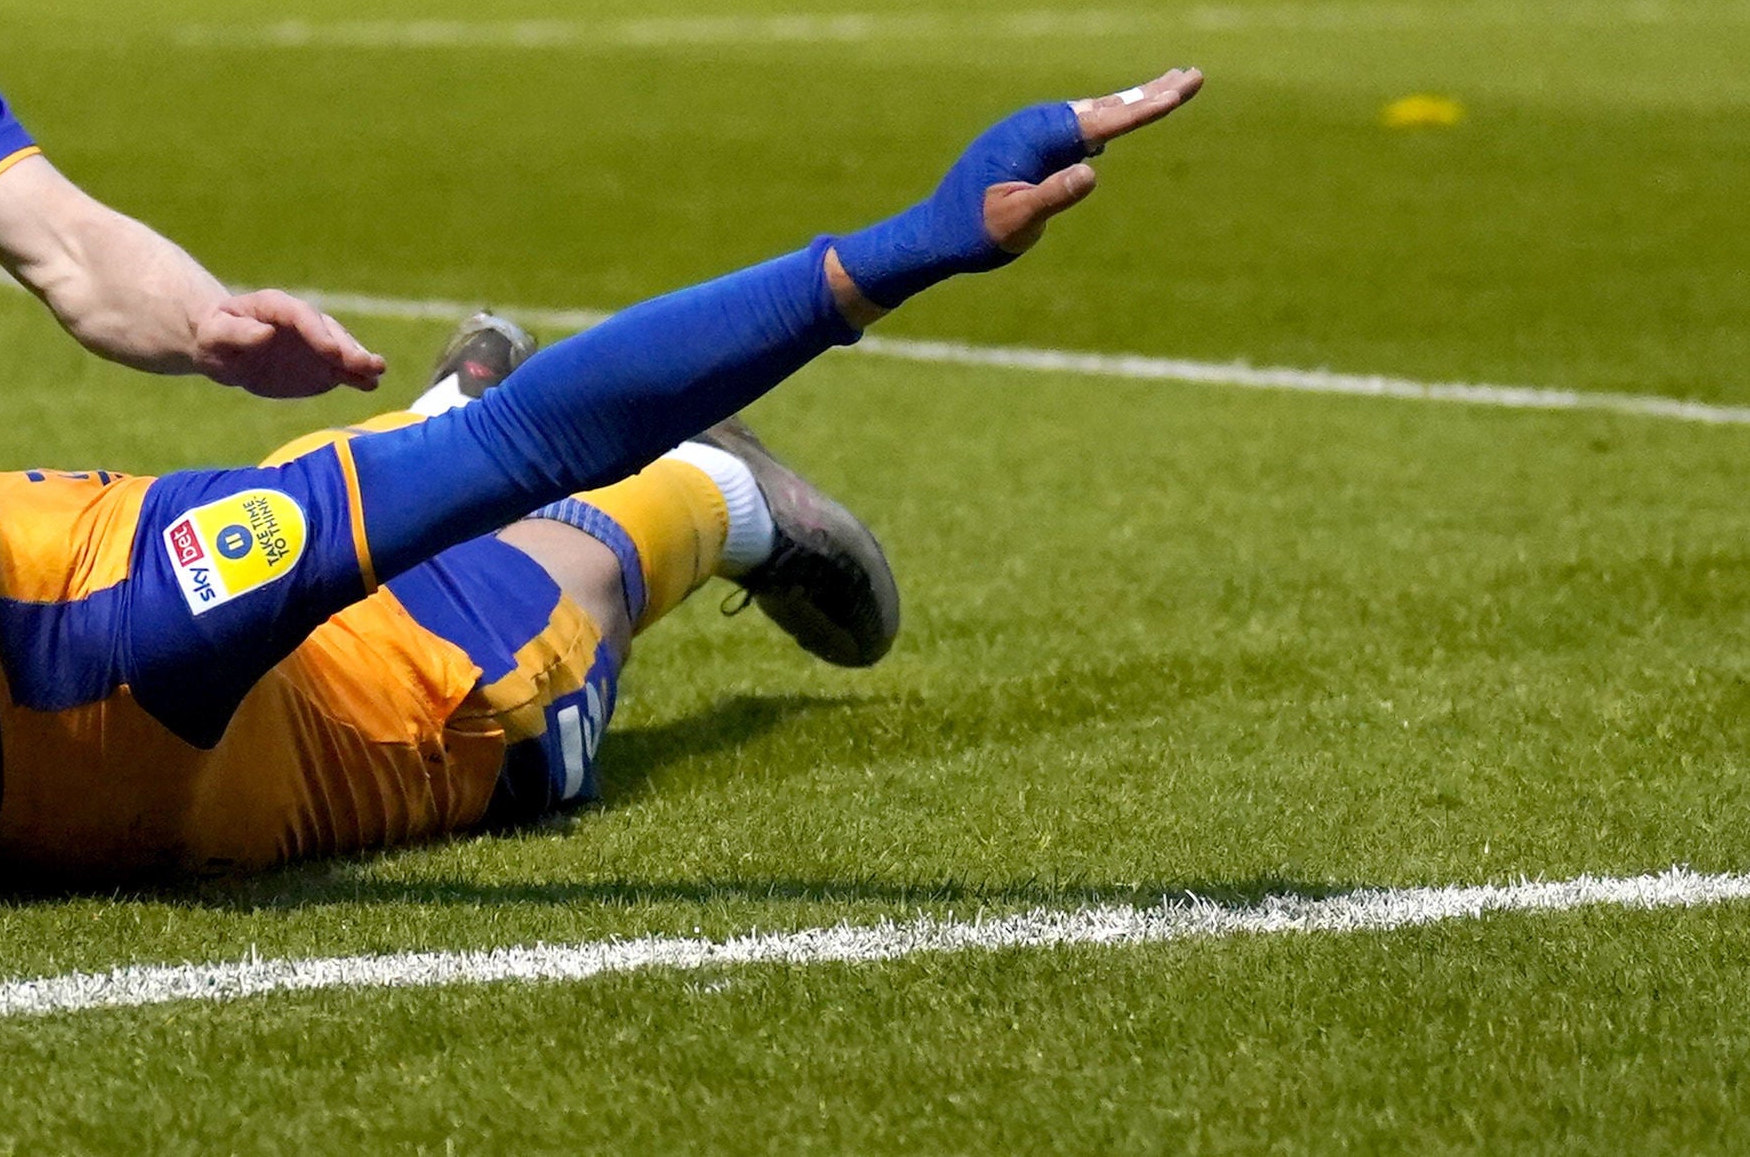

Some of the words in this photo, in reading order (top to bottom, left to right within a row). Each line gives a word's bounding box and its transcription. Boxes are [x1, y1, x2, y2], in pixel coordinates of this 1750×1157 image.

[173, 526, 199, 563] bet
[256, 530, 279, 567] TAKE
[274, 538, 290, 558] TO
[189, 567, 216, 602] sky
